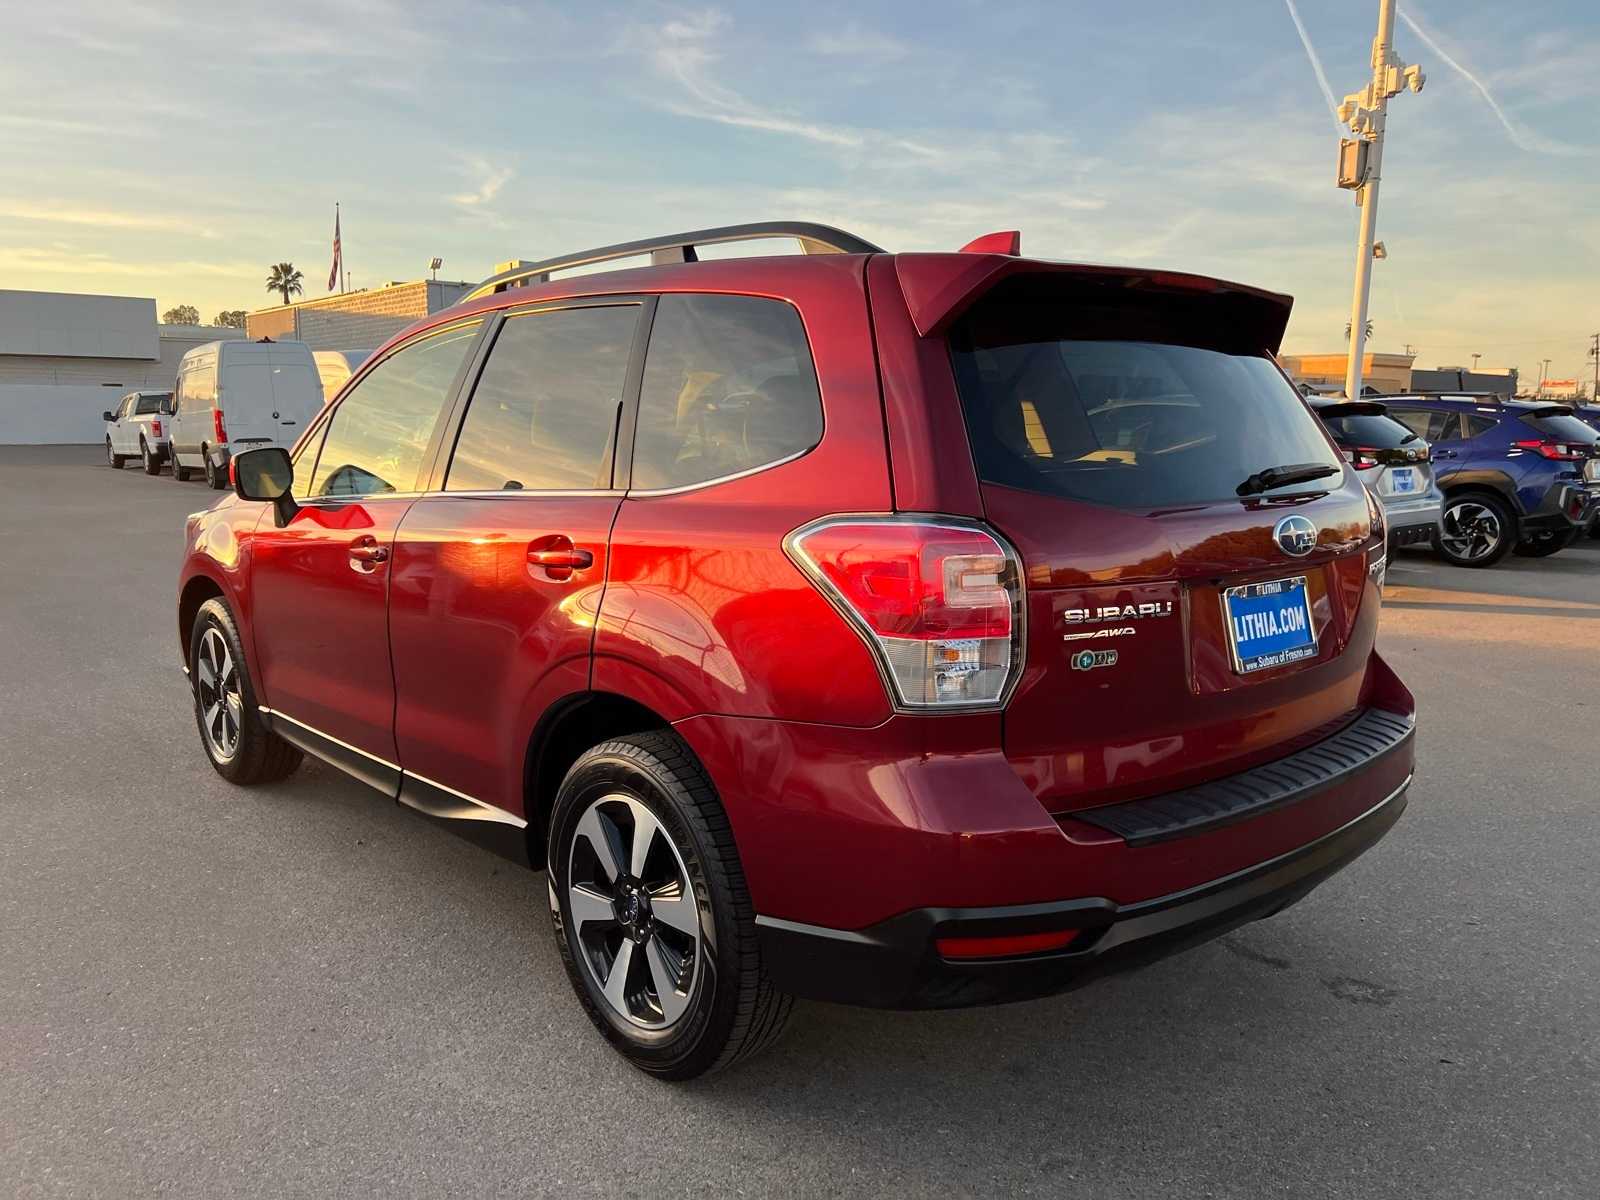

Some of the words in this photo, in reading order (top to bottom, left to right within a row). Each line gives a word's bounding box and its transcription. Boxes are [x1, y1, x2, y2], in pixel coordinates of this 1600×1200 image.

[1064, 601, 1172, 625] SUBARU
[1233, 605, 1306, 642] LITHIA.COM
[1092, 627, 1136, 639] AWD
